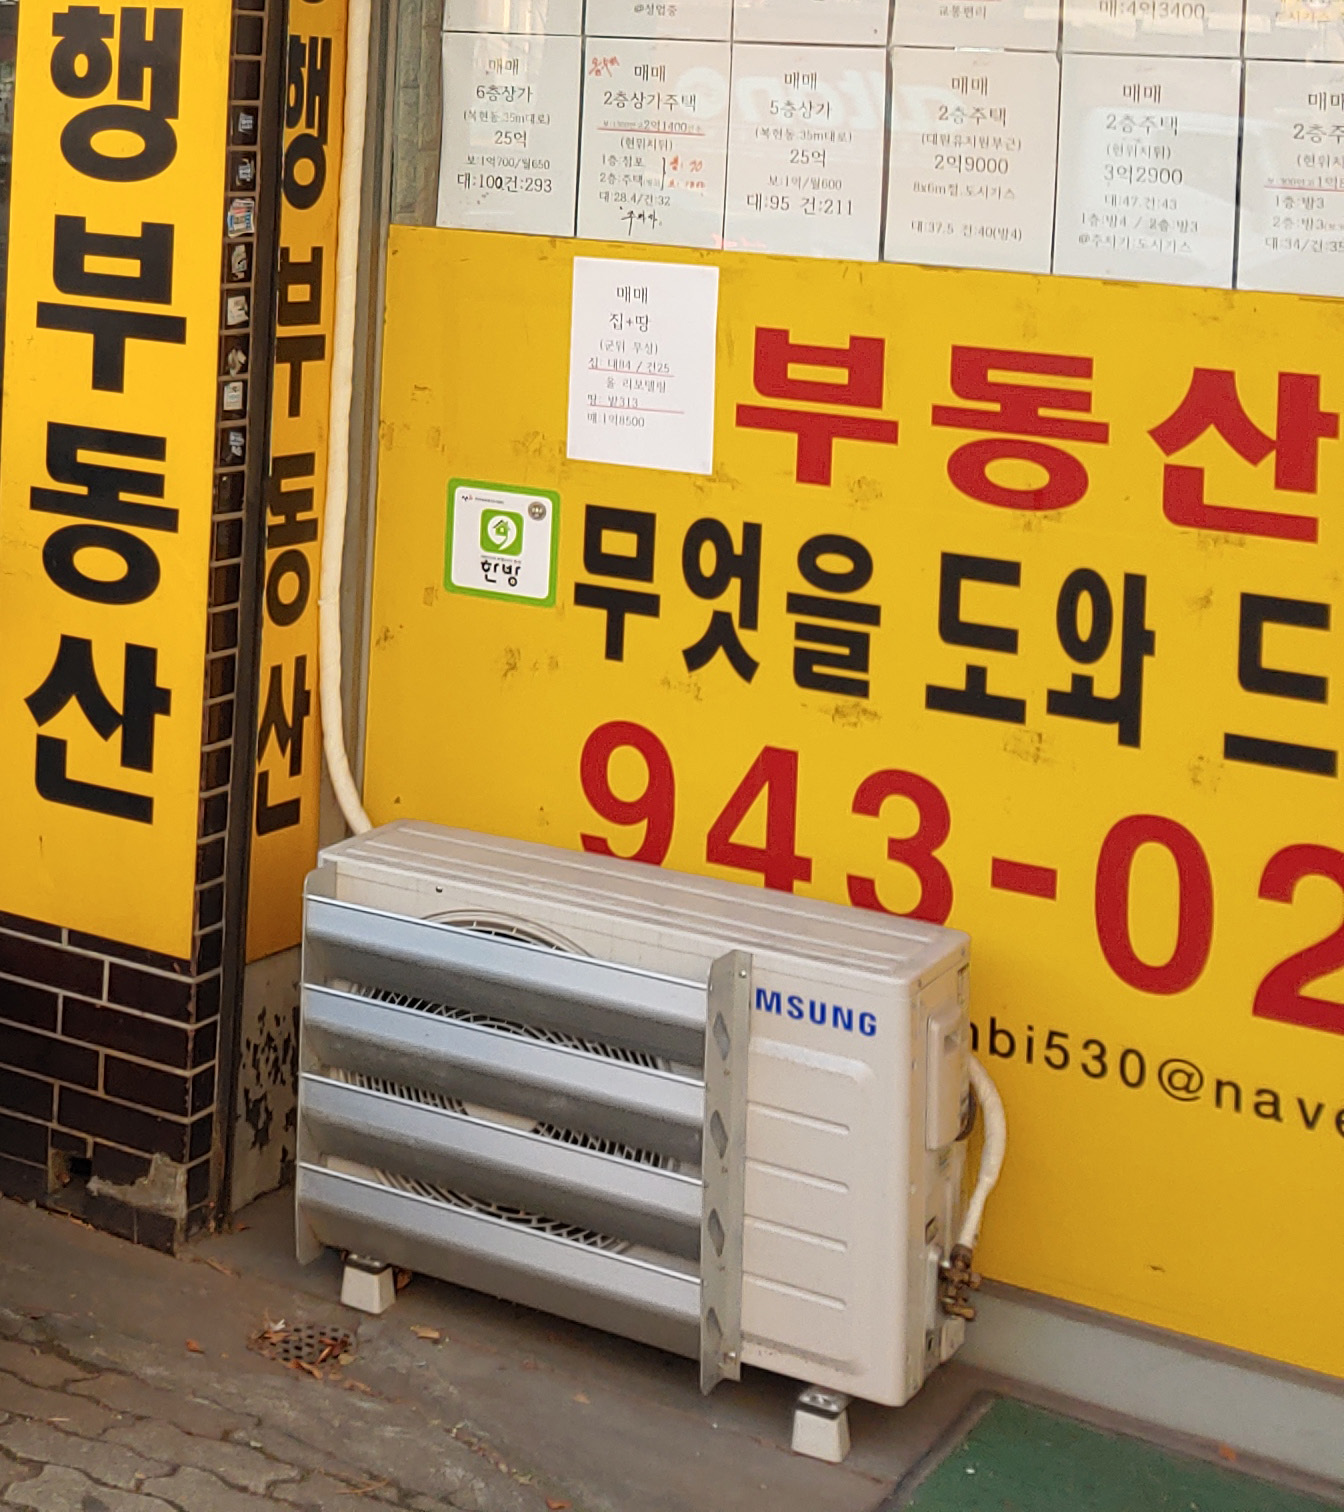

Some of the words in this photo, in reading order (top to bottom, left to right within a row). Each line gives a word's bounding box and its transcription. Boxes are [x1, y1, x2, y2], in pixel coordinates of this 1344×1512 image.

[487, 58, 520, 76] 매매
[633, 63, 667, 83] 매매
[784, 71, 818, 91] 매매
[951, 76, 988, 96] 매매
[476, 85, 534, 103] 6층상가
[602, 91, 697, 112] 2층상가주택
[1122, 83, 1162, 105] 매매
[769, 99, 833, 121] 5층상가
[494, 129, 528, 148] 25억
[789, 148, 827, 168] 25억
[933, 153, 1010, 175] 2억9000
[1103, 163, 1184, 186] 3억2900
[746, 193, 791, 213] 대:95
[800, 196, 854, 217] 건:211
[616, 285, 649, 304] 매매
[608, 313, 651, 333] 집+땅
[734, 325, 1342, 545] 부동산
[480, 559, 522, 588] 한방
[572, 502, 883, 702] 무엇을
[923, 550, 1157, 750] 도와
[753, 986, 879, 1039] MSUNG
